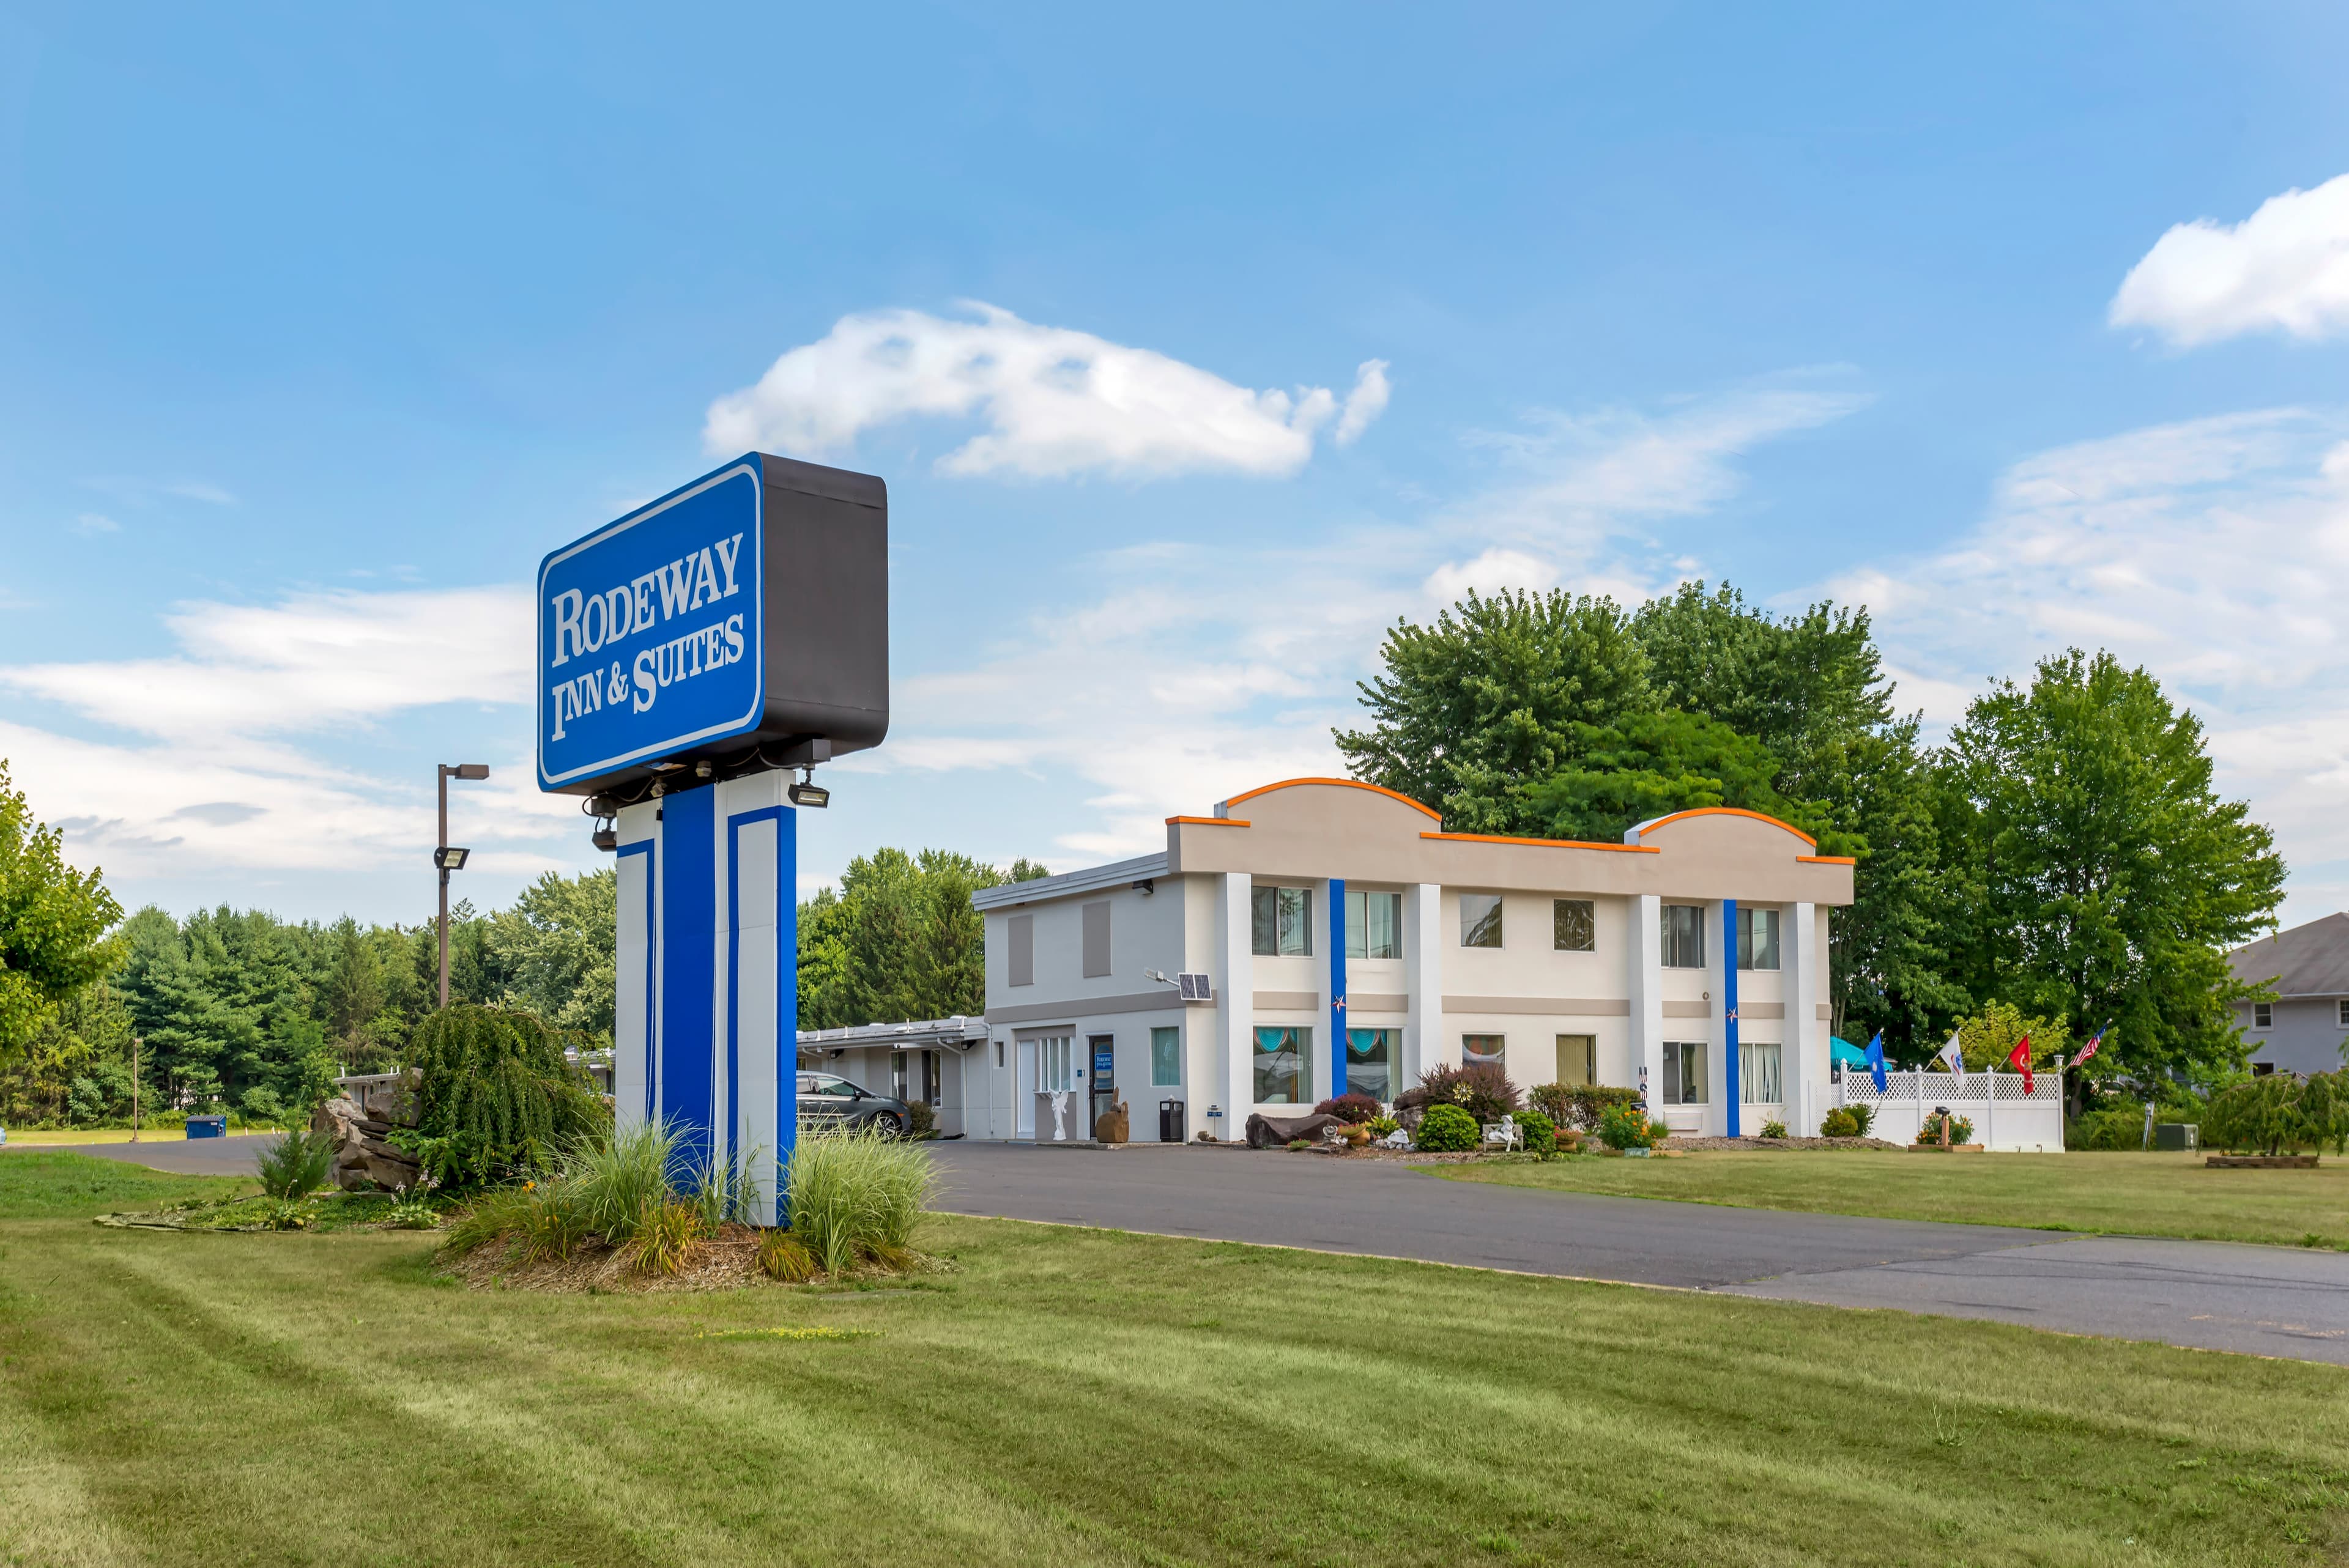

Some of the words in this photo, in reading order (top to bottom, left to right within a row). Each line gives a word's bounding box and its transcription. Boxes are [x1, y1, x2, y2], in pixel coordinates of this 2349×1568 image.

[552, 532, 743, 668] RODEWAY
[552, 668, 604, 742] INN
[607, 661, 629, 705] &
[633, 613, 744, 714] SUITES
